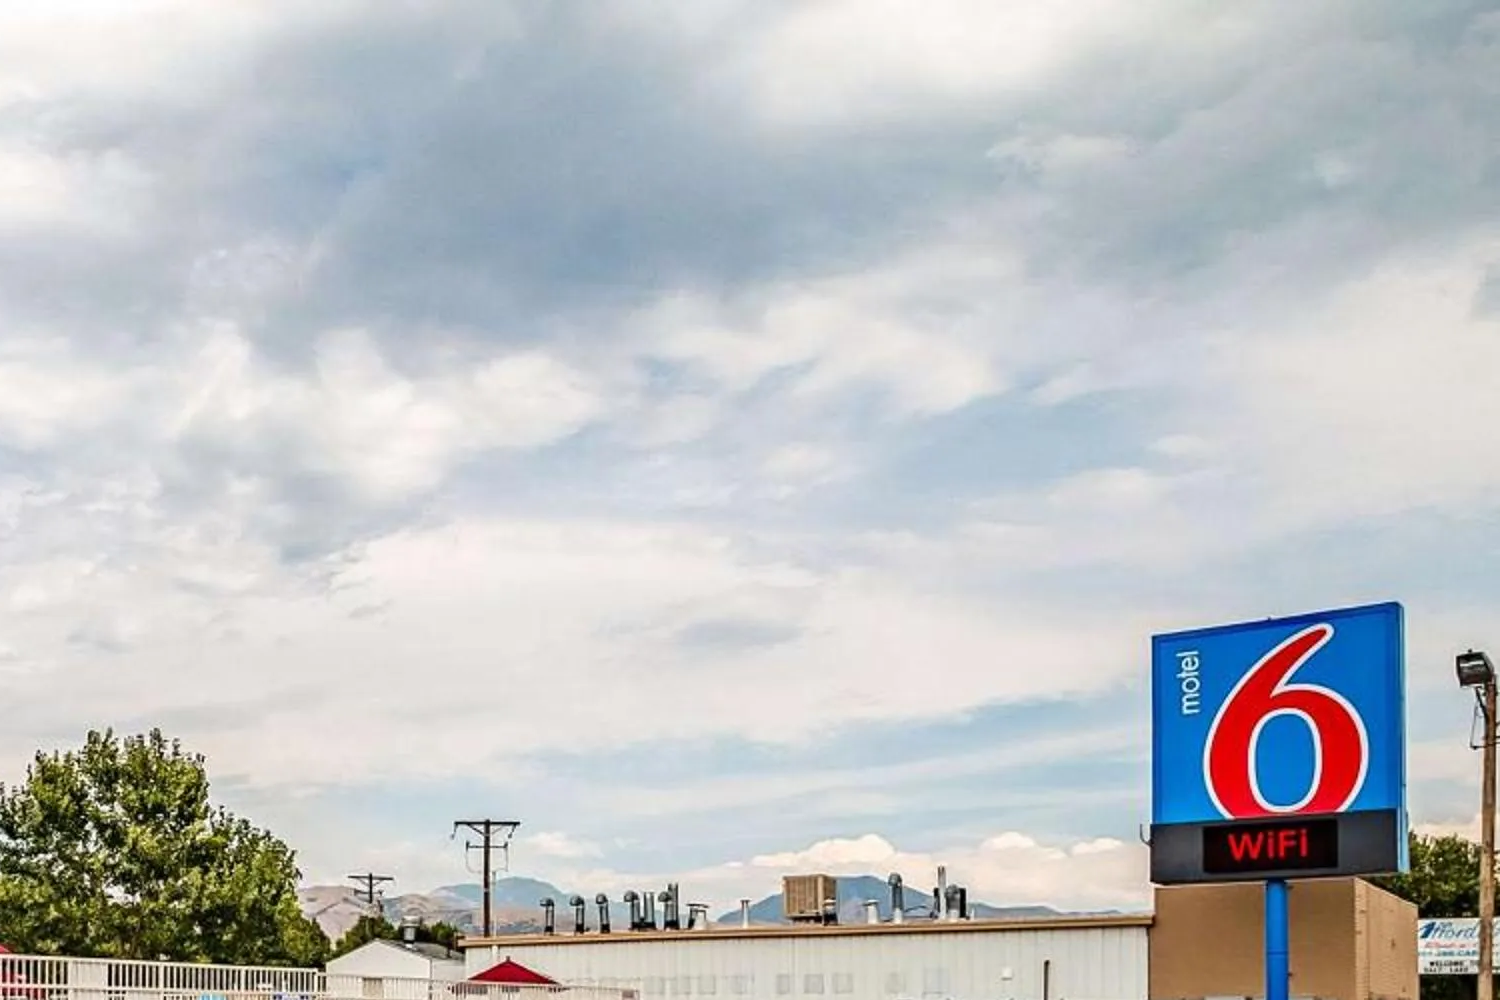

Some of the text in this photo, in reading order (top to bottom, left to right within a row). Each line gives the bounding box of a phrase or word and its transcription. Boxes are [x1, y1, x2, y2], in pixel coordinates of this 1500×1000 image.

[1175, 651, 1200, 714] motel
[1203, 623, 1369, 820] 6
[1227, 828, 1308, 861] WiFi
